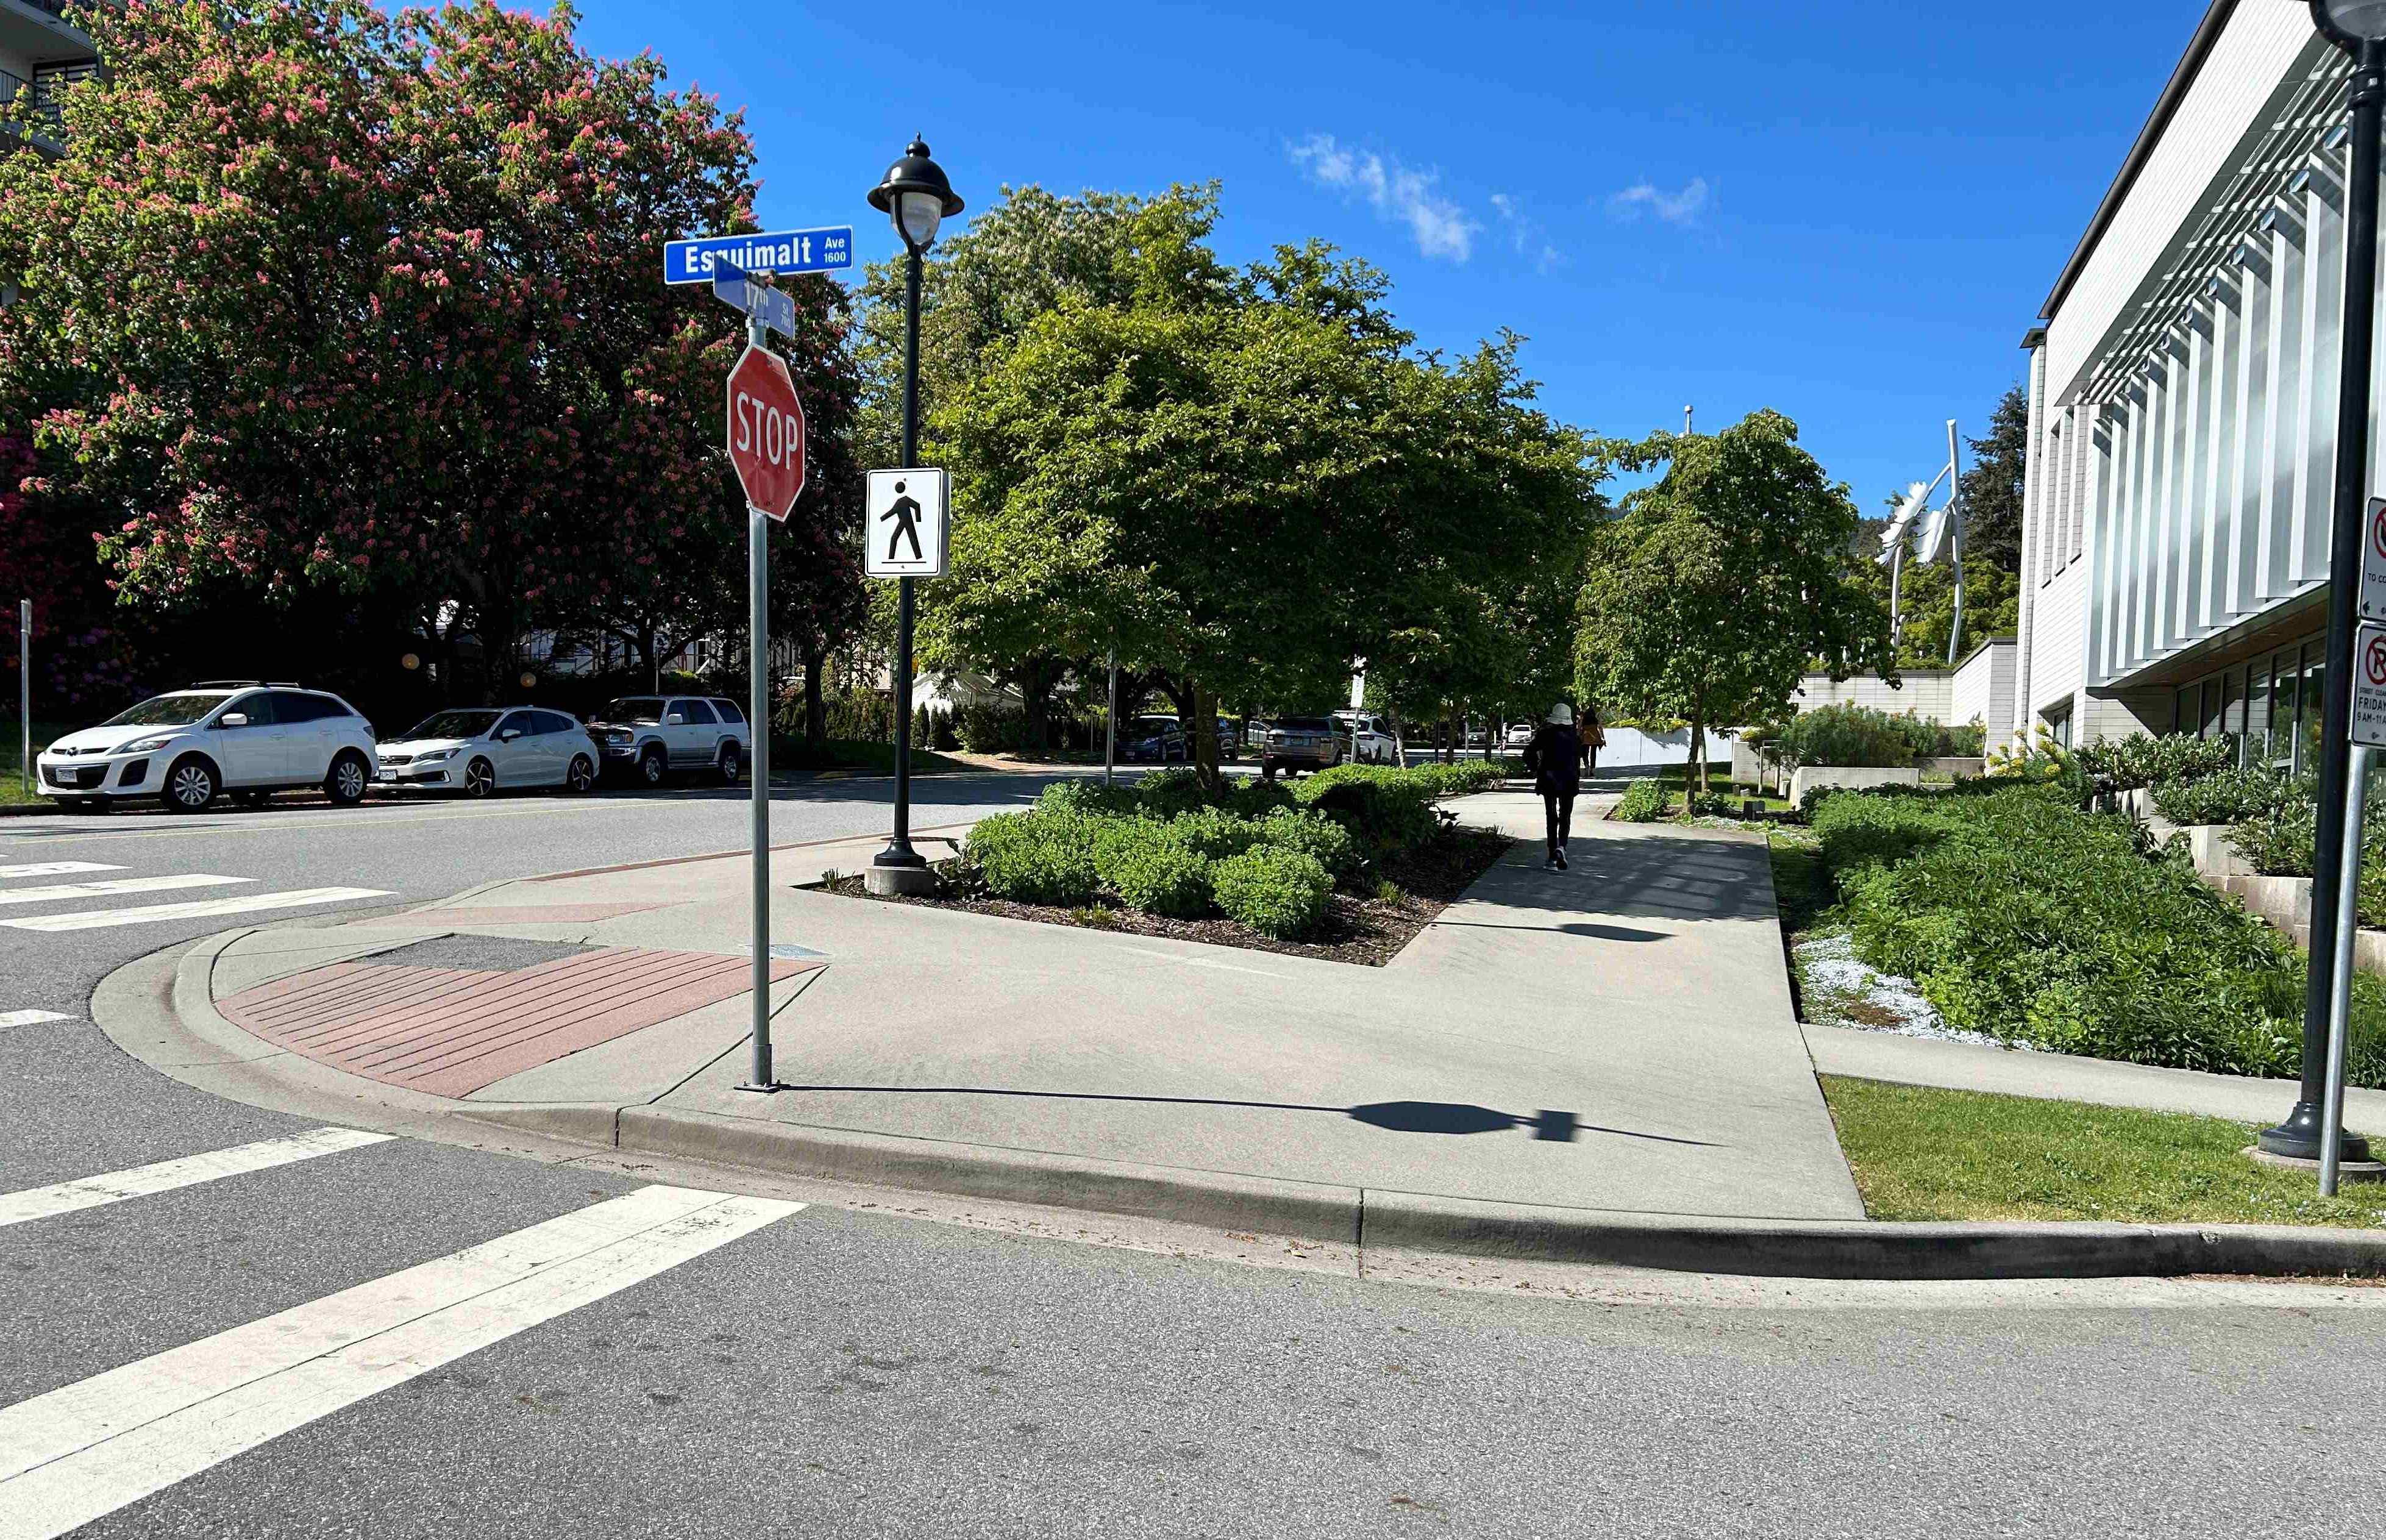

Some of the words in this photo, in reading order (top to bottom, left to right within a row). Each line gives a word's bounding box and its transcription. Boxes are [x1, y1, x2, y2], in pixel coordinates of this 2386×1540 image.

[825, 237, 845, 249] Ave
[685, 236, 811, 273] Esuimalt
[824, 251, 846, 263] 1600
[736, 391, 798, 470] STOP
[2368, 572, 2377, 582] TO
